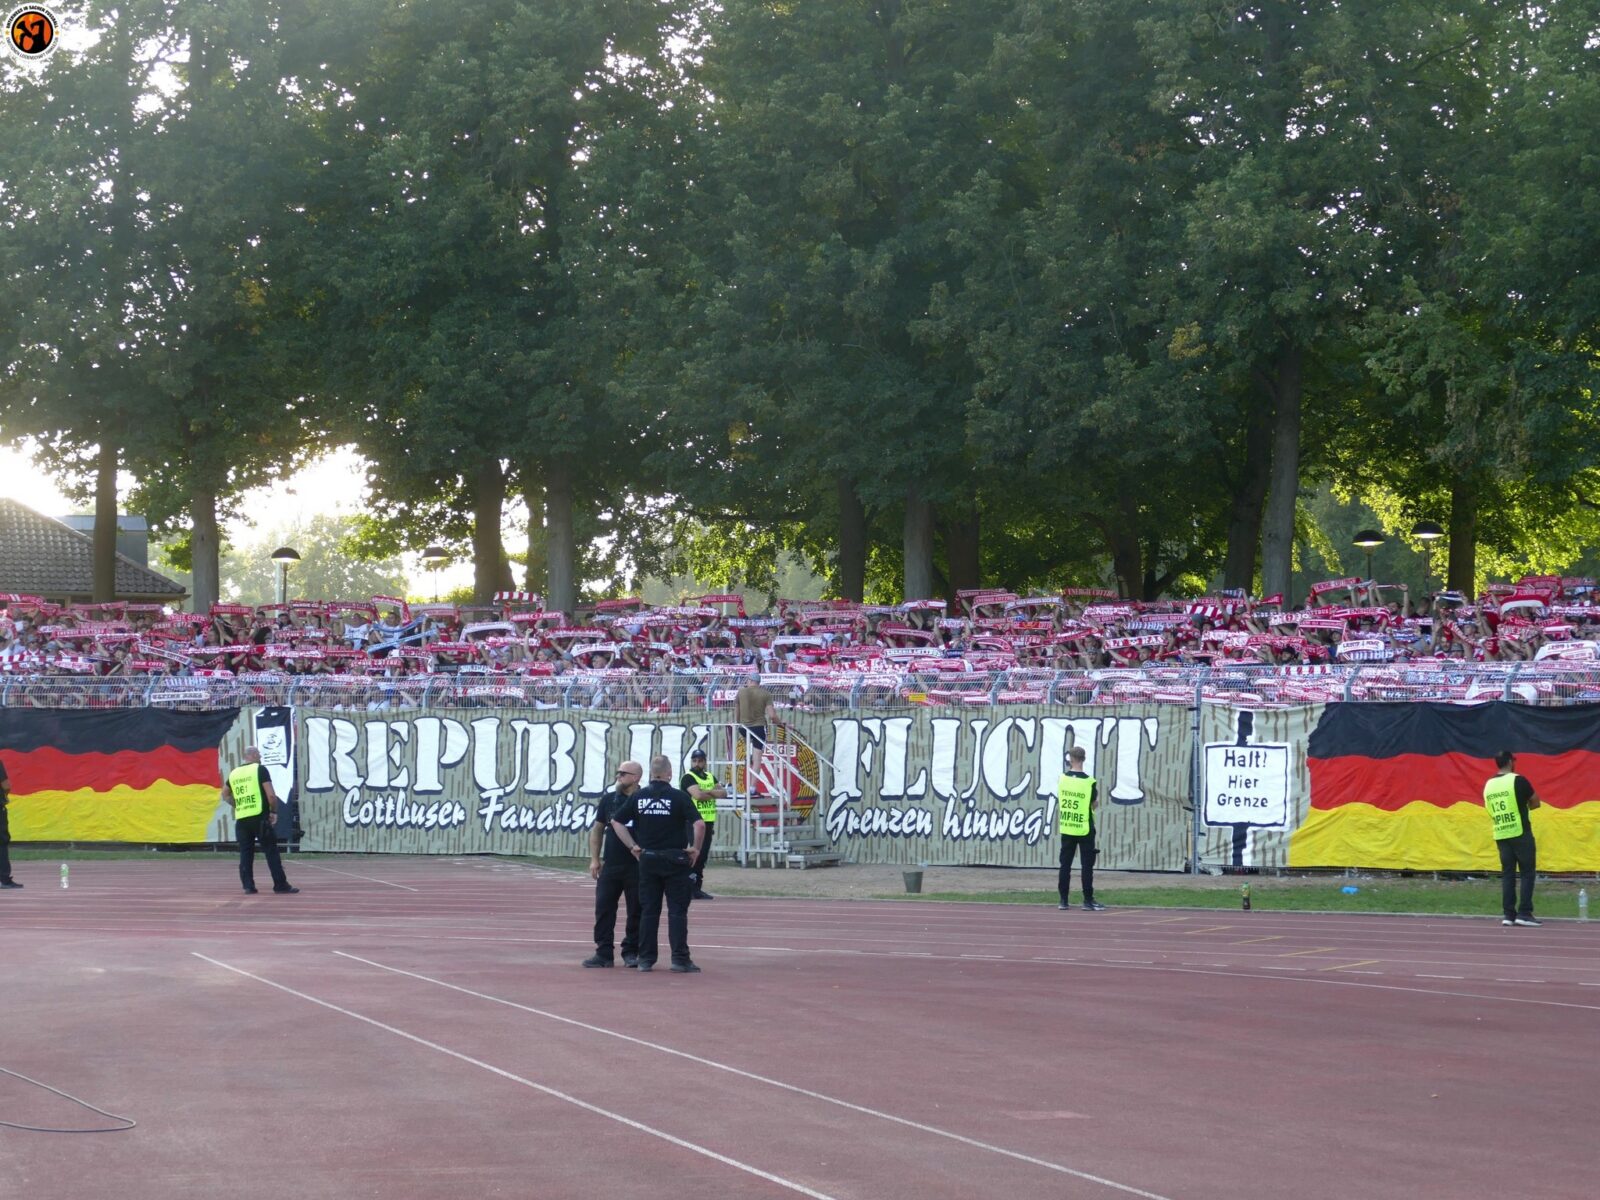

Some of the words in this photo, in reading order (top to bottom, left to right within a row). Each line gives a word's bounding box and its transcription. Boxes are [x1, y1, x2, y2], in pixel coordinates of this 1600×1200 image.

[829, 716, 1160, 803] FLUCHT
[1223, 749, 1268, 768] Halt!
[1228, 775, 1260, 789] Hier
[235, 794, 256, 807] MPIRE
[1061, 790, 1086, 799] TEWARD
[1217, 793, 1268, 808] Grenze
[1061, 798, 1080, 810] 285
[343, 786, 467, 829] Cottbuser
[477, 787, 598, 834] Fanatis
[825, 791, 934, 843] Grenzen
[942, 793, 1058, 846] hinweg!
[1060, 811, 1084, 823] MPIRE
[1494, 812, 1517, 826] PIRE
